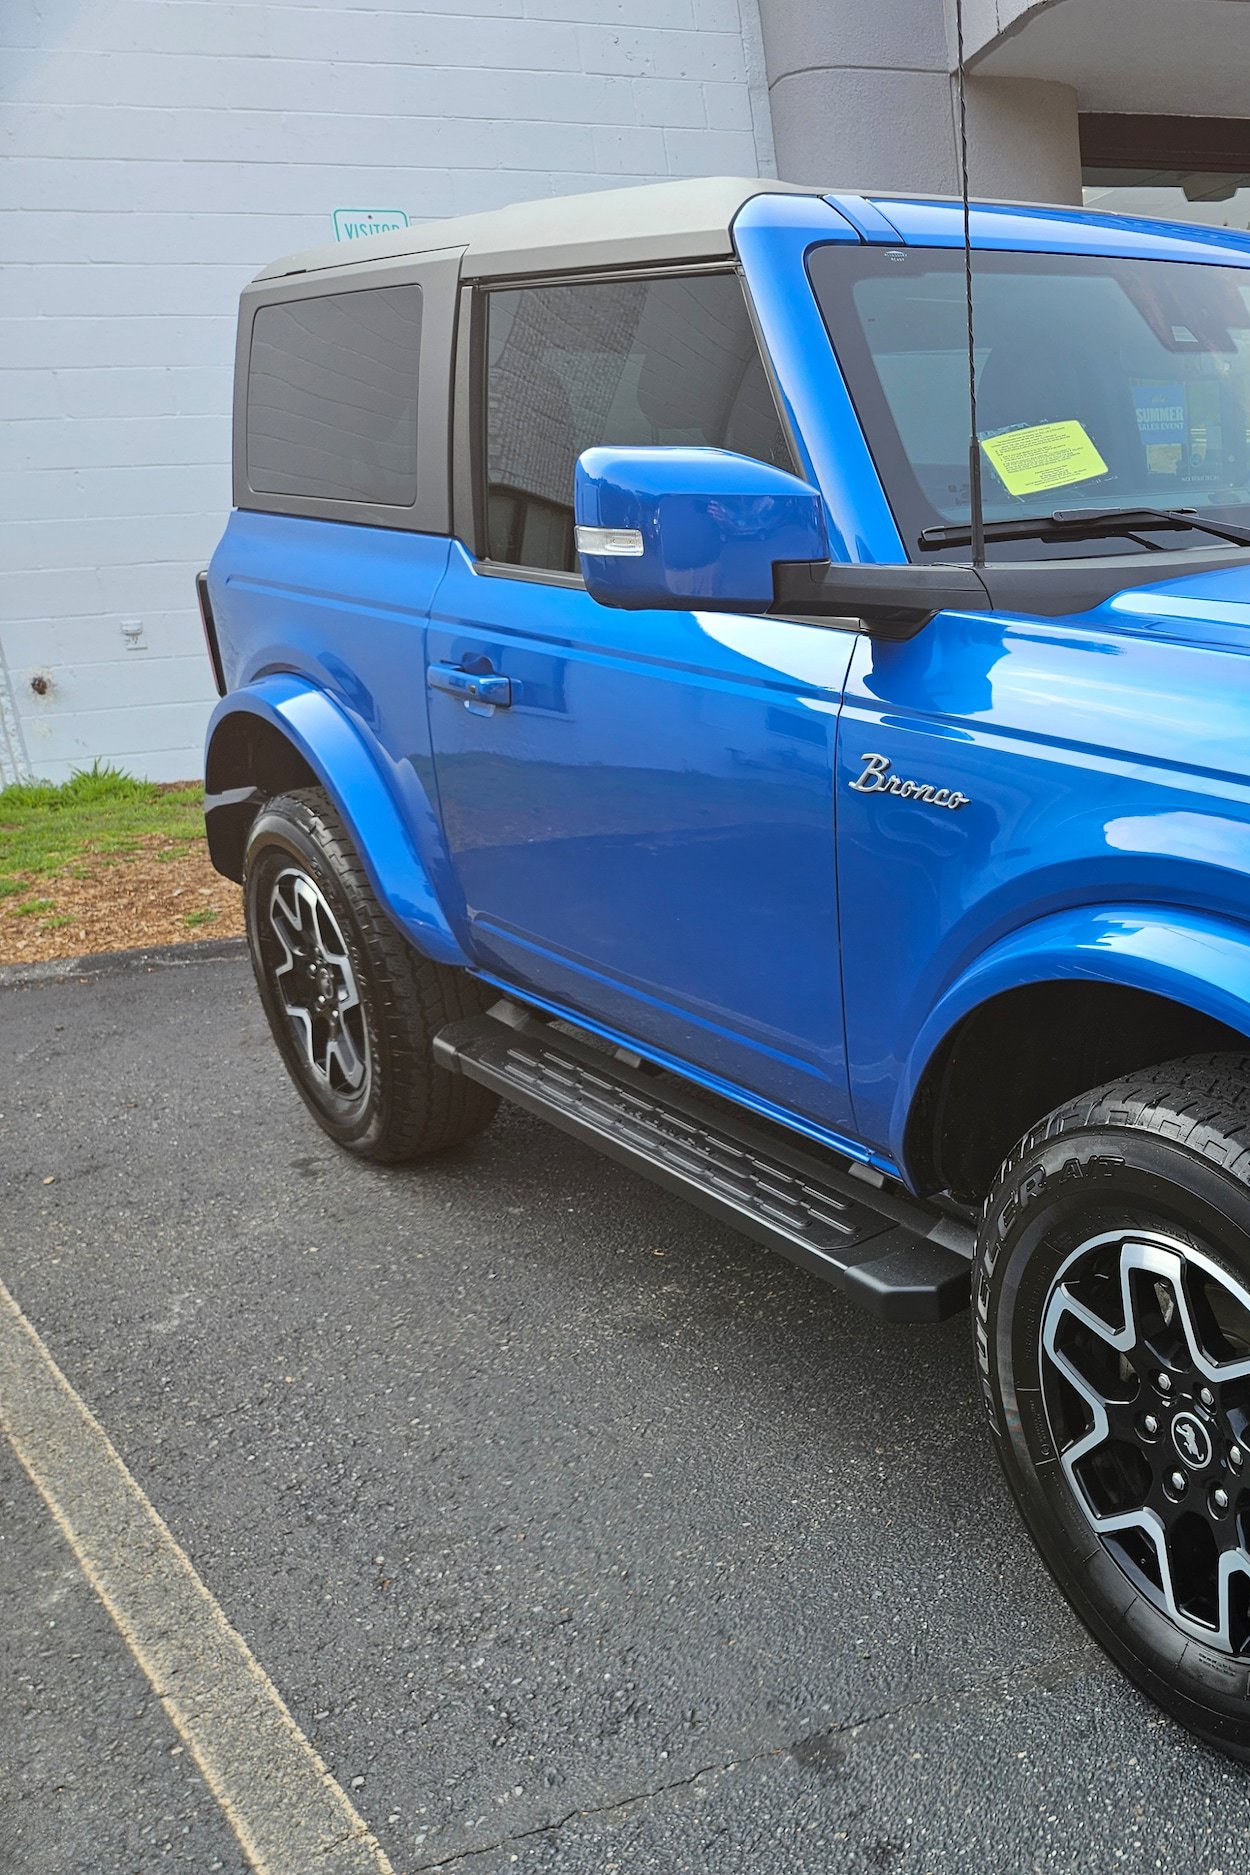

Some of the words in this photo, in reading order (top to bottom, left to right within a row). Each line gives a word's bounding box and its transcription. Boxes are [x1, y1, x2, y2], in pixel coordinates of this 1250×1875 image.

[1135, 406, 1184, 423] SUMMER
[1161, 422, 1184, 430] EVENT
[848, 753, 970, 809] Bronco
[1060, 1154, 1126, 1184] A/T
